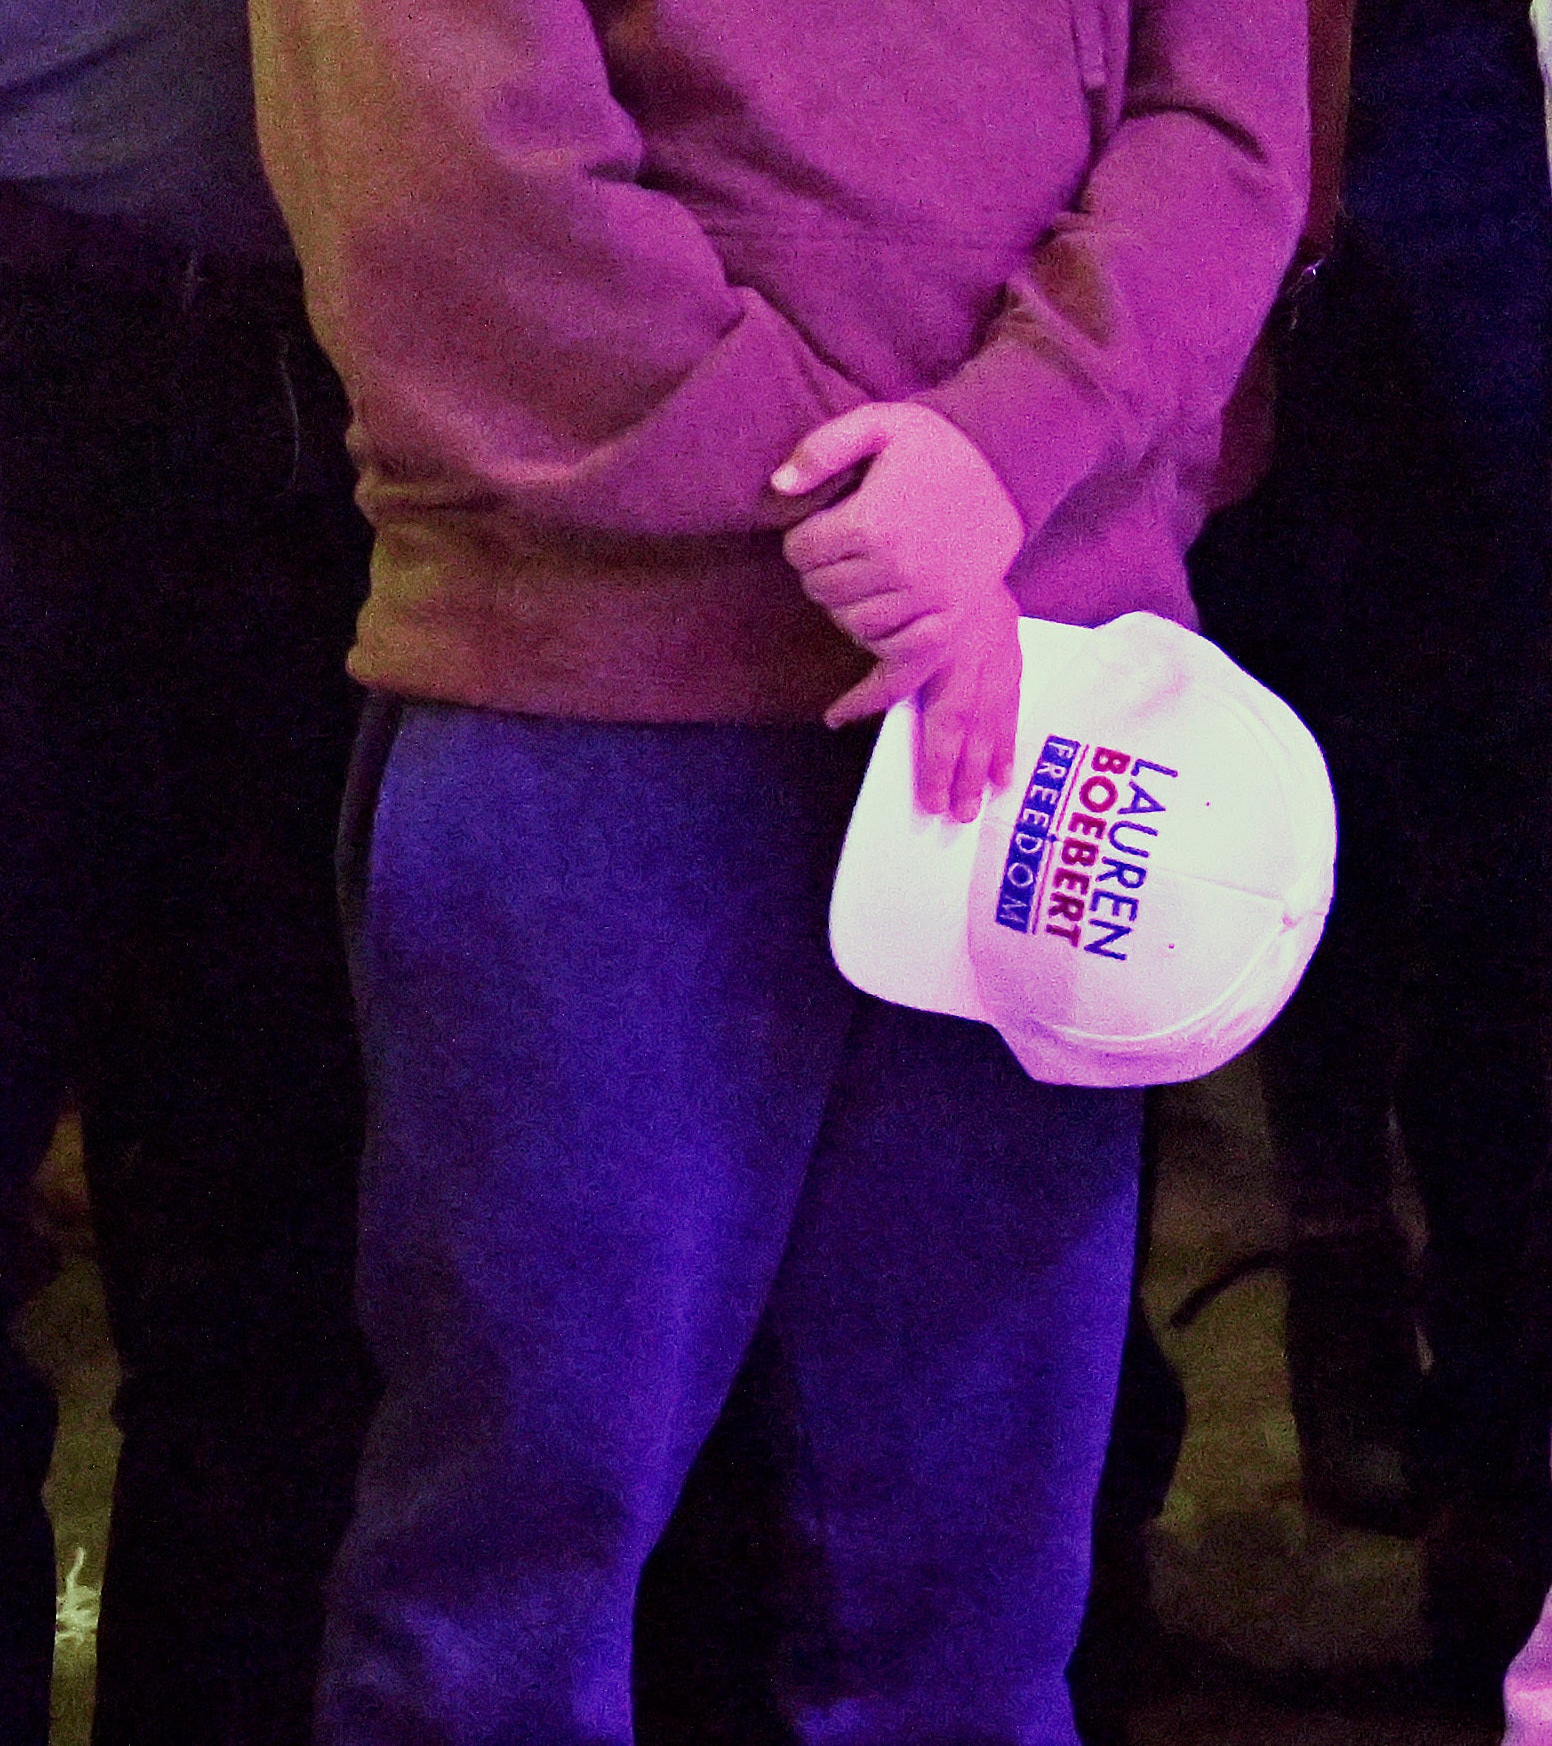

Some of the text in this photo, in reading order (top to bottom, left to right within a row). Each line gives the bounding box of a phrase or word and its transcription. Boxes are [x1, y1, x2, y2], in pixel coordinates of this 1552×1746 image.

[998, 740, 1075, 926] FREEDOM
[1045, 746, 1132, 948] BOEBERT
[1083, 758, 1179, 961] LAUREN
